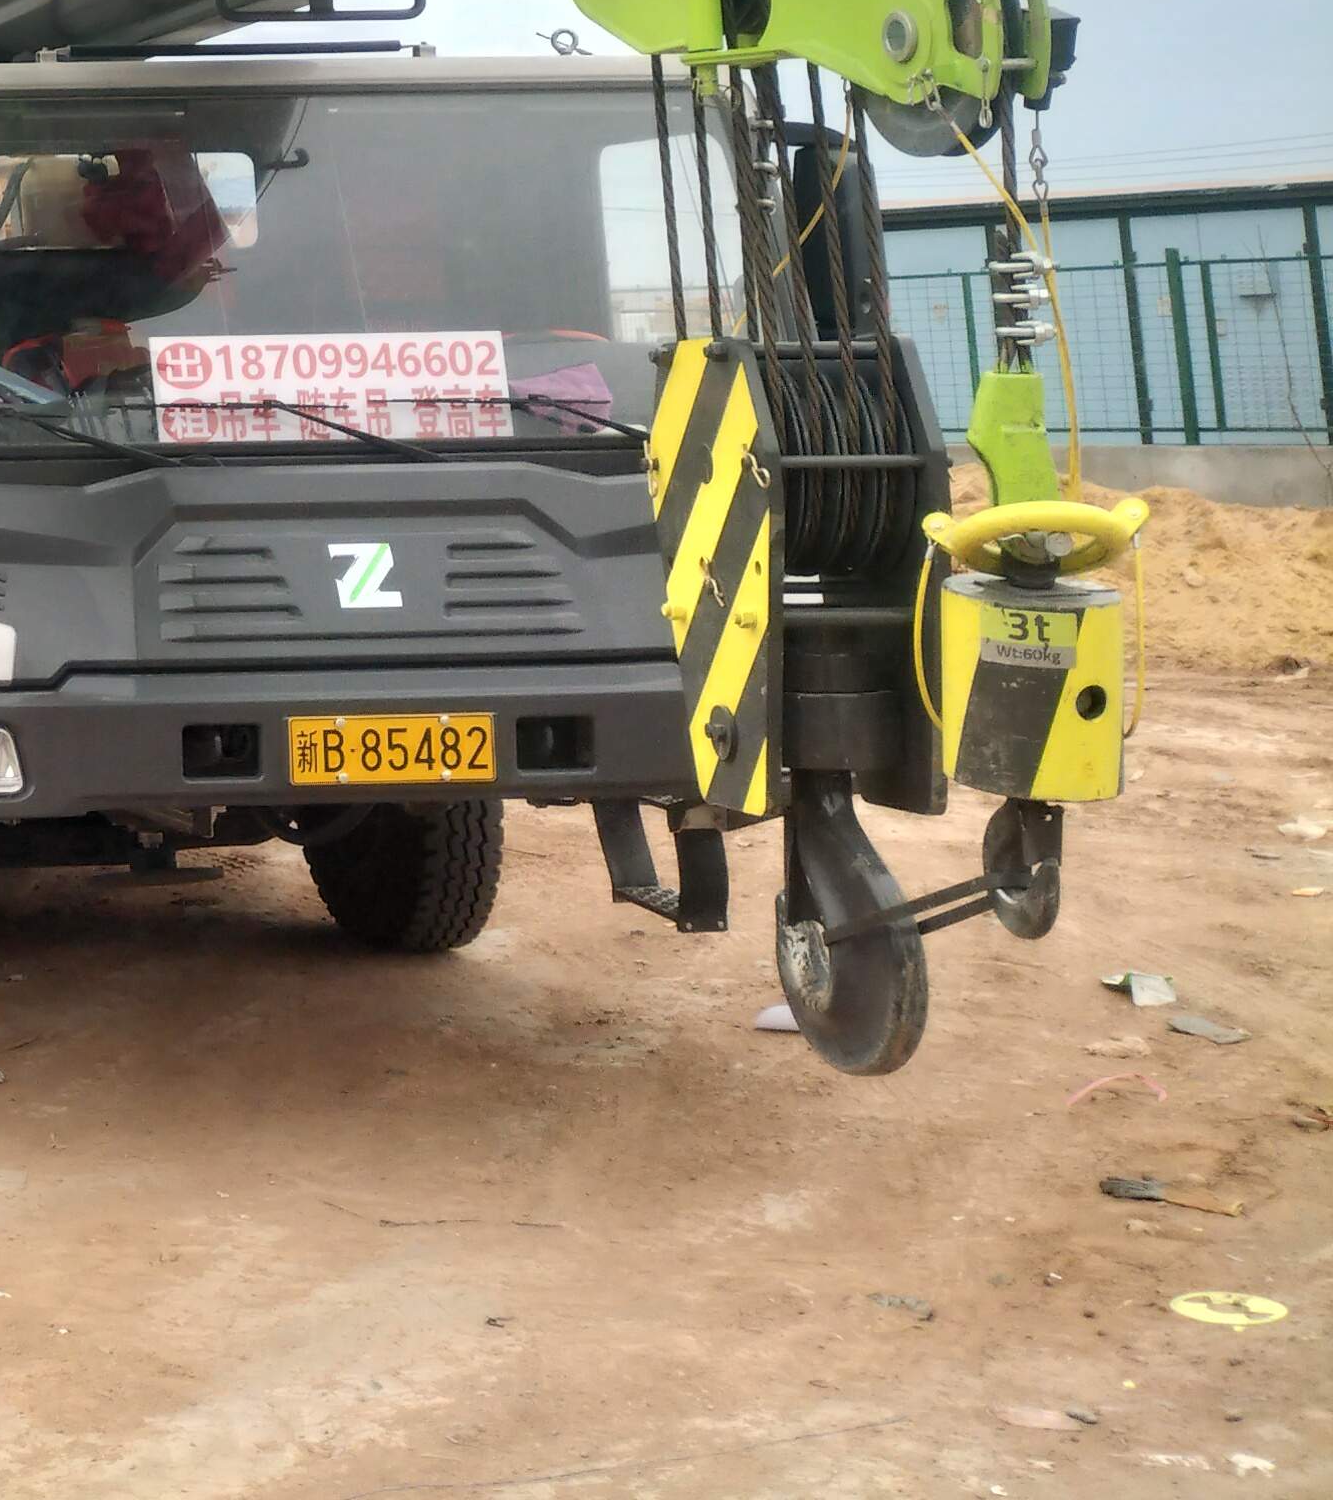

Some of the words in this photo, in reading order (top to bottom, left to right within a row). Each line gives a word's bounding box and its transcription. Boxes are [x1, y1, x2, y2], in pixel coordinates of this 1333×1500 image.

[215, 340, 500, 381] 18709946602
[220, 388, 281, 441] 吊车
[1008, 611, 1051, 643] 3t
